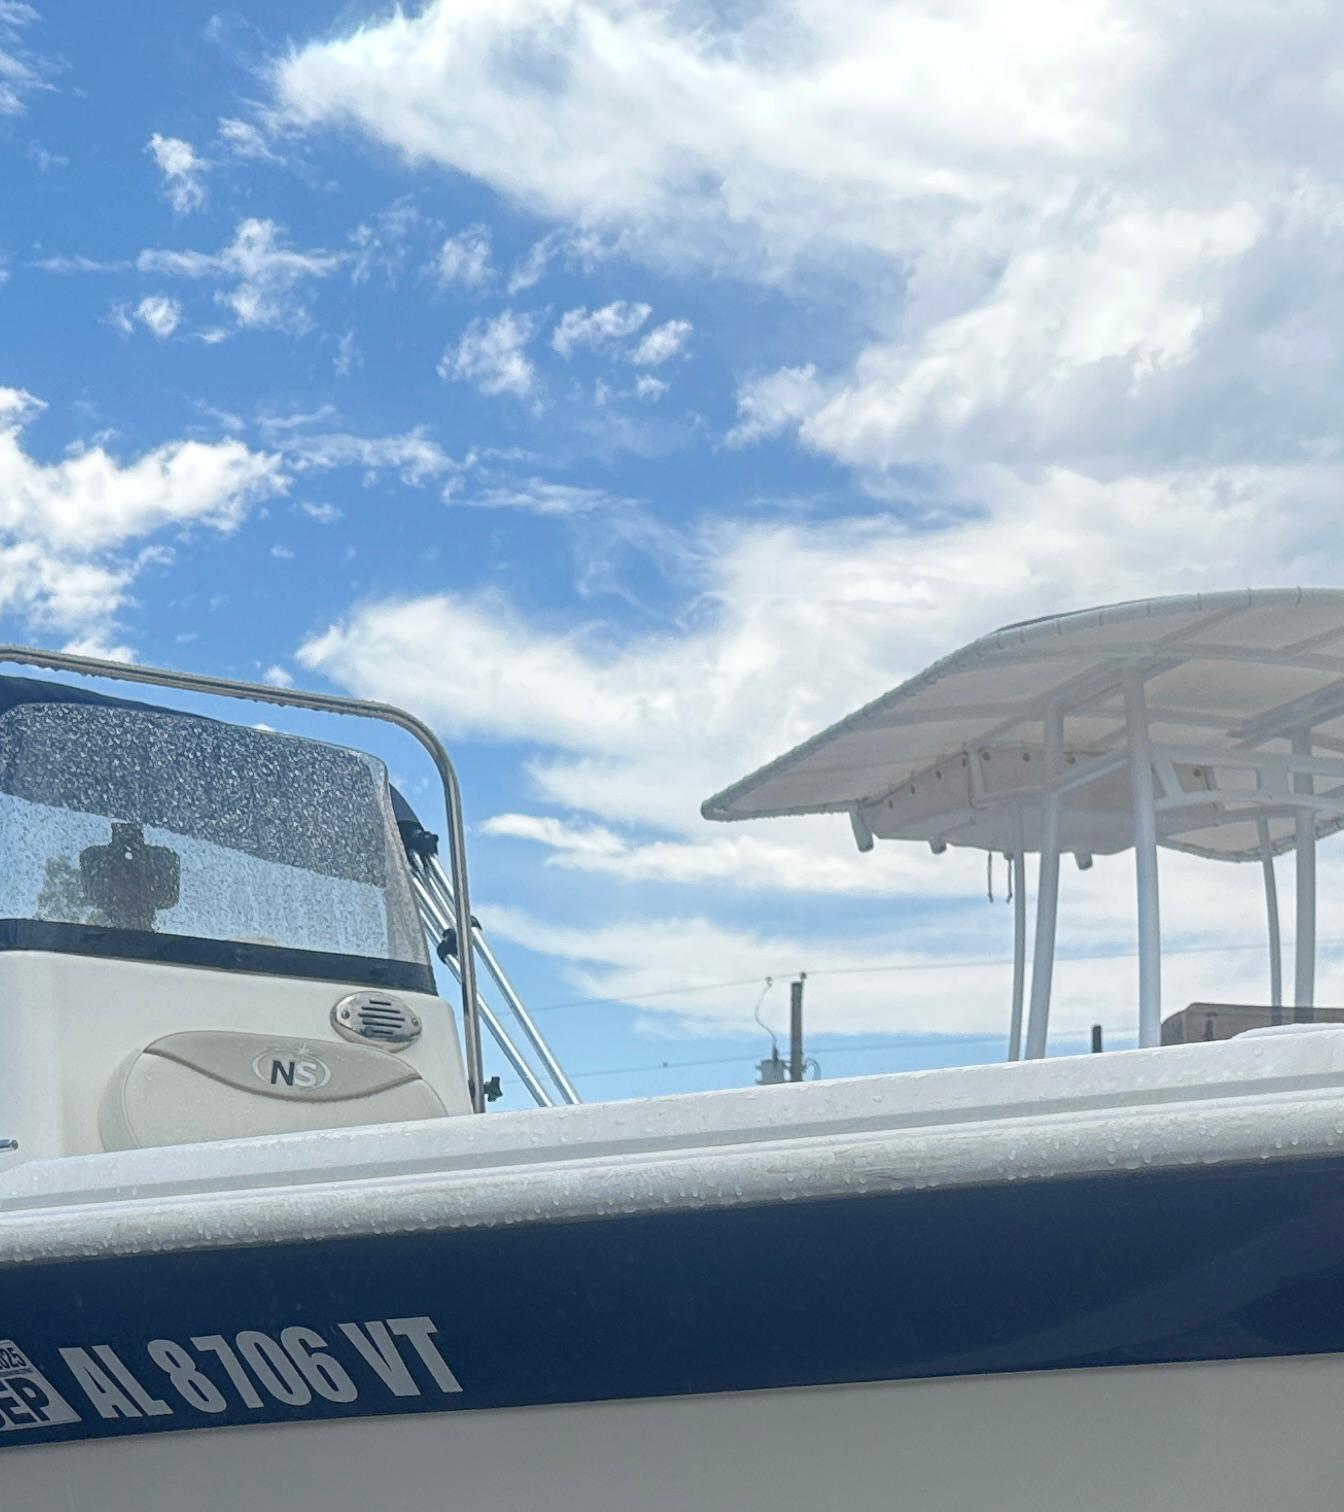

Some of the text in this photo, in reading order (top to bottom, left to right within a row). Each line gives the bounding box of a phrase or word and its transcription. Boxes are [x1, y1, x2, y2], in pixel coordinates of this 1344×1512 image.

[59, 1316, 463, 1418] AL 8706 VT
